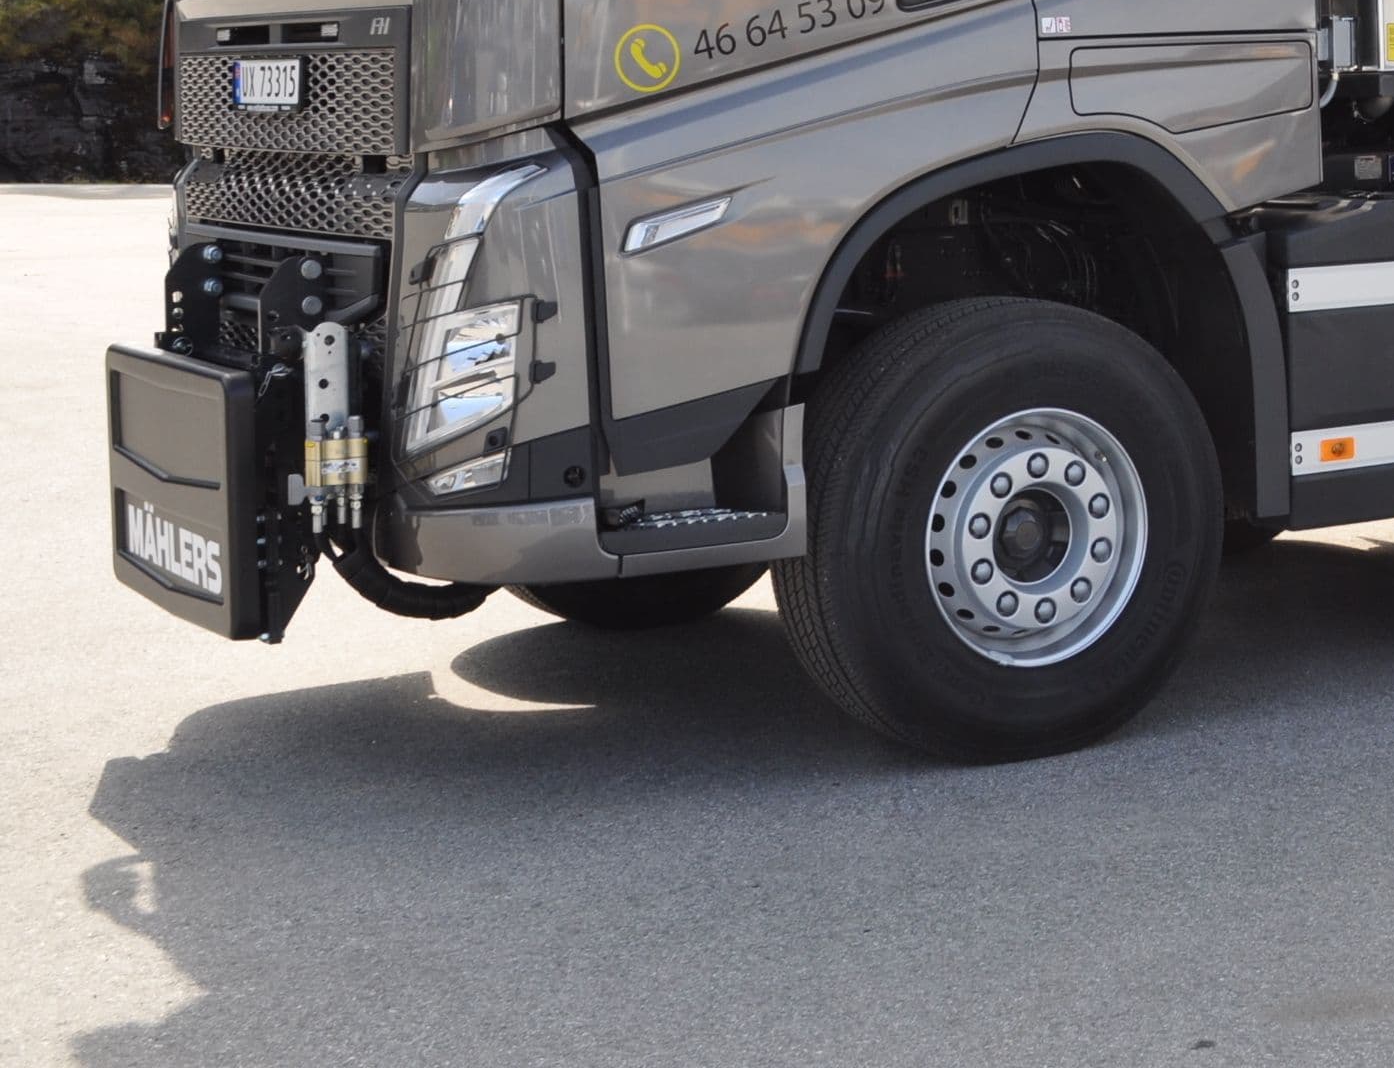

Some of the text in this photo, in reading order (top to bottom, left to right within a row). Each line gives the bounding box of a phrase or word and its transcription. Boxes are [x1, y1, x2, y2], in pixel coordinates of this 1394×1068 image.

[693, 21, 737, 60] 46
[745, 8, 788, 48] 64
[260, 65, 297, 98] 73315
[127, 500, 223, 595] MÄHLERS
